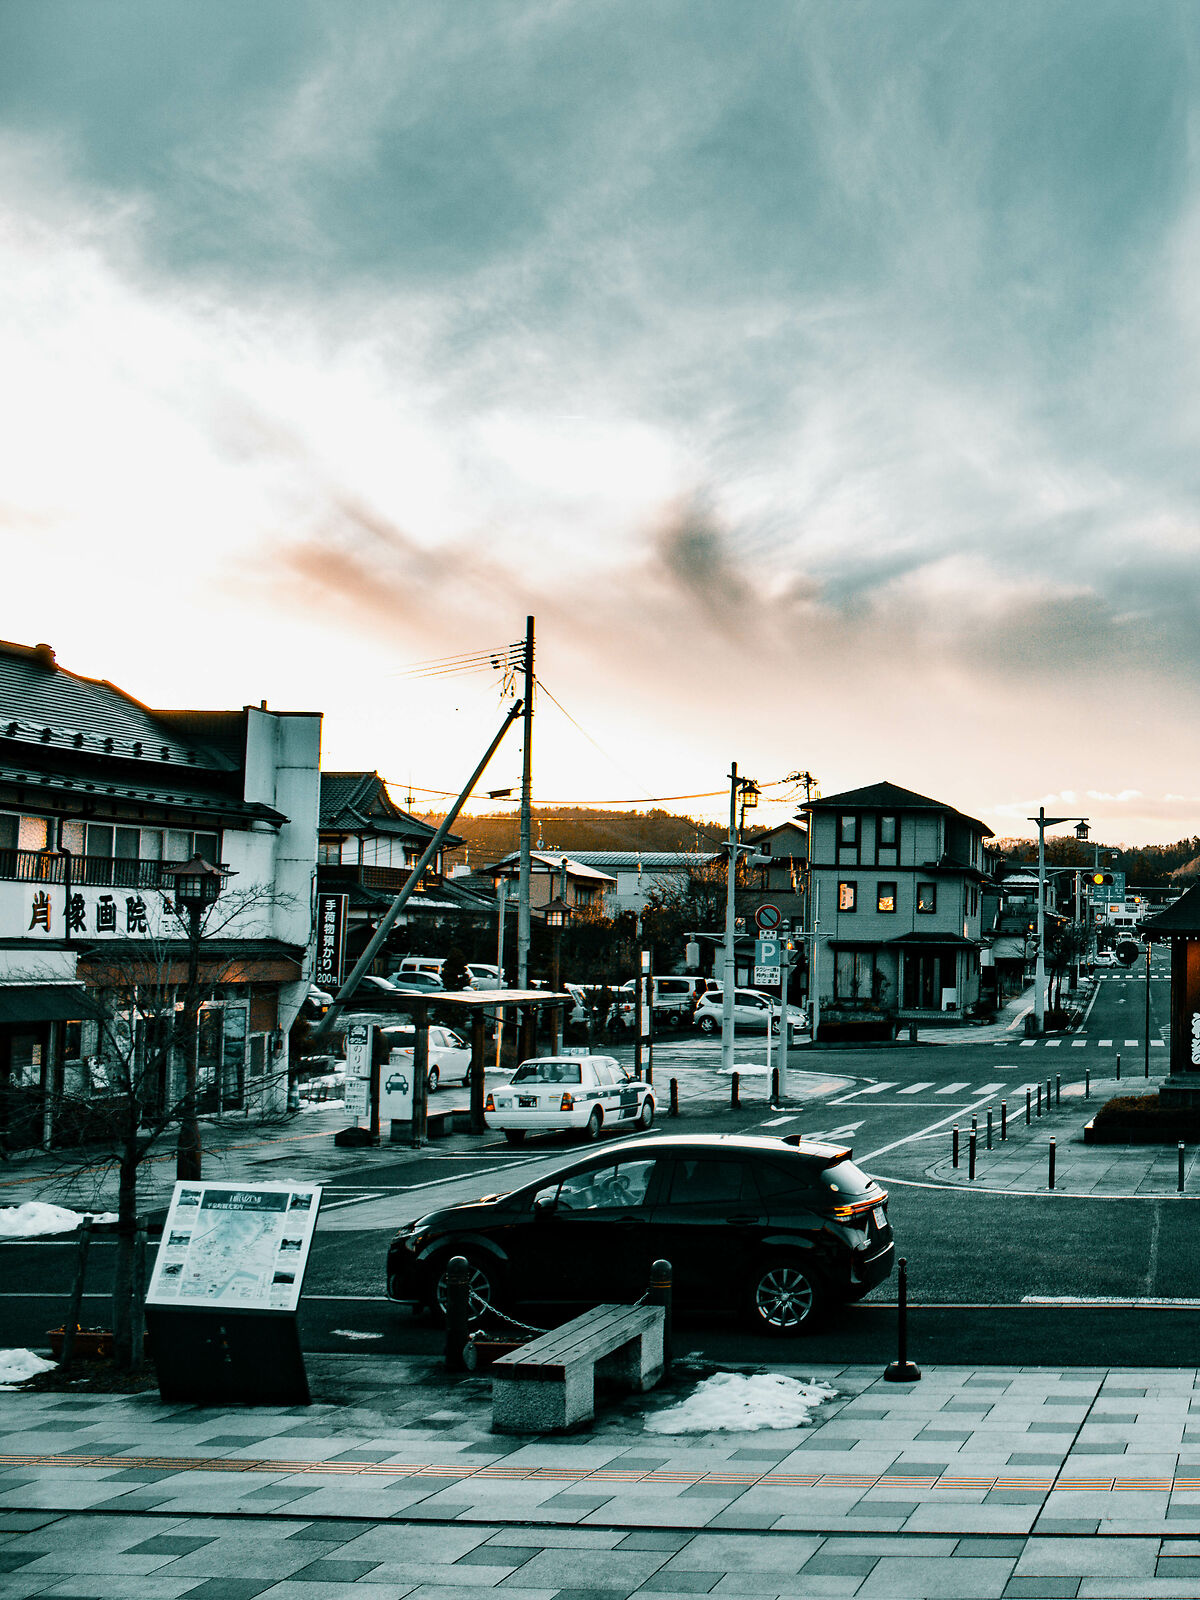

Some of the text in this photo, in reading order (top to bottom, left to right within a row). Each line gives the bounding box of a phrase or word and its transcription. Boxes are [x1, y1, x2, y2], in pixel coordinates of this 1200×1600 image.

[28, 890, 147, 933] 肖像画院
[322, 899, 337, 971] 手荷物預かり
[353, 1045, 362, 1074] のりば
